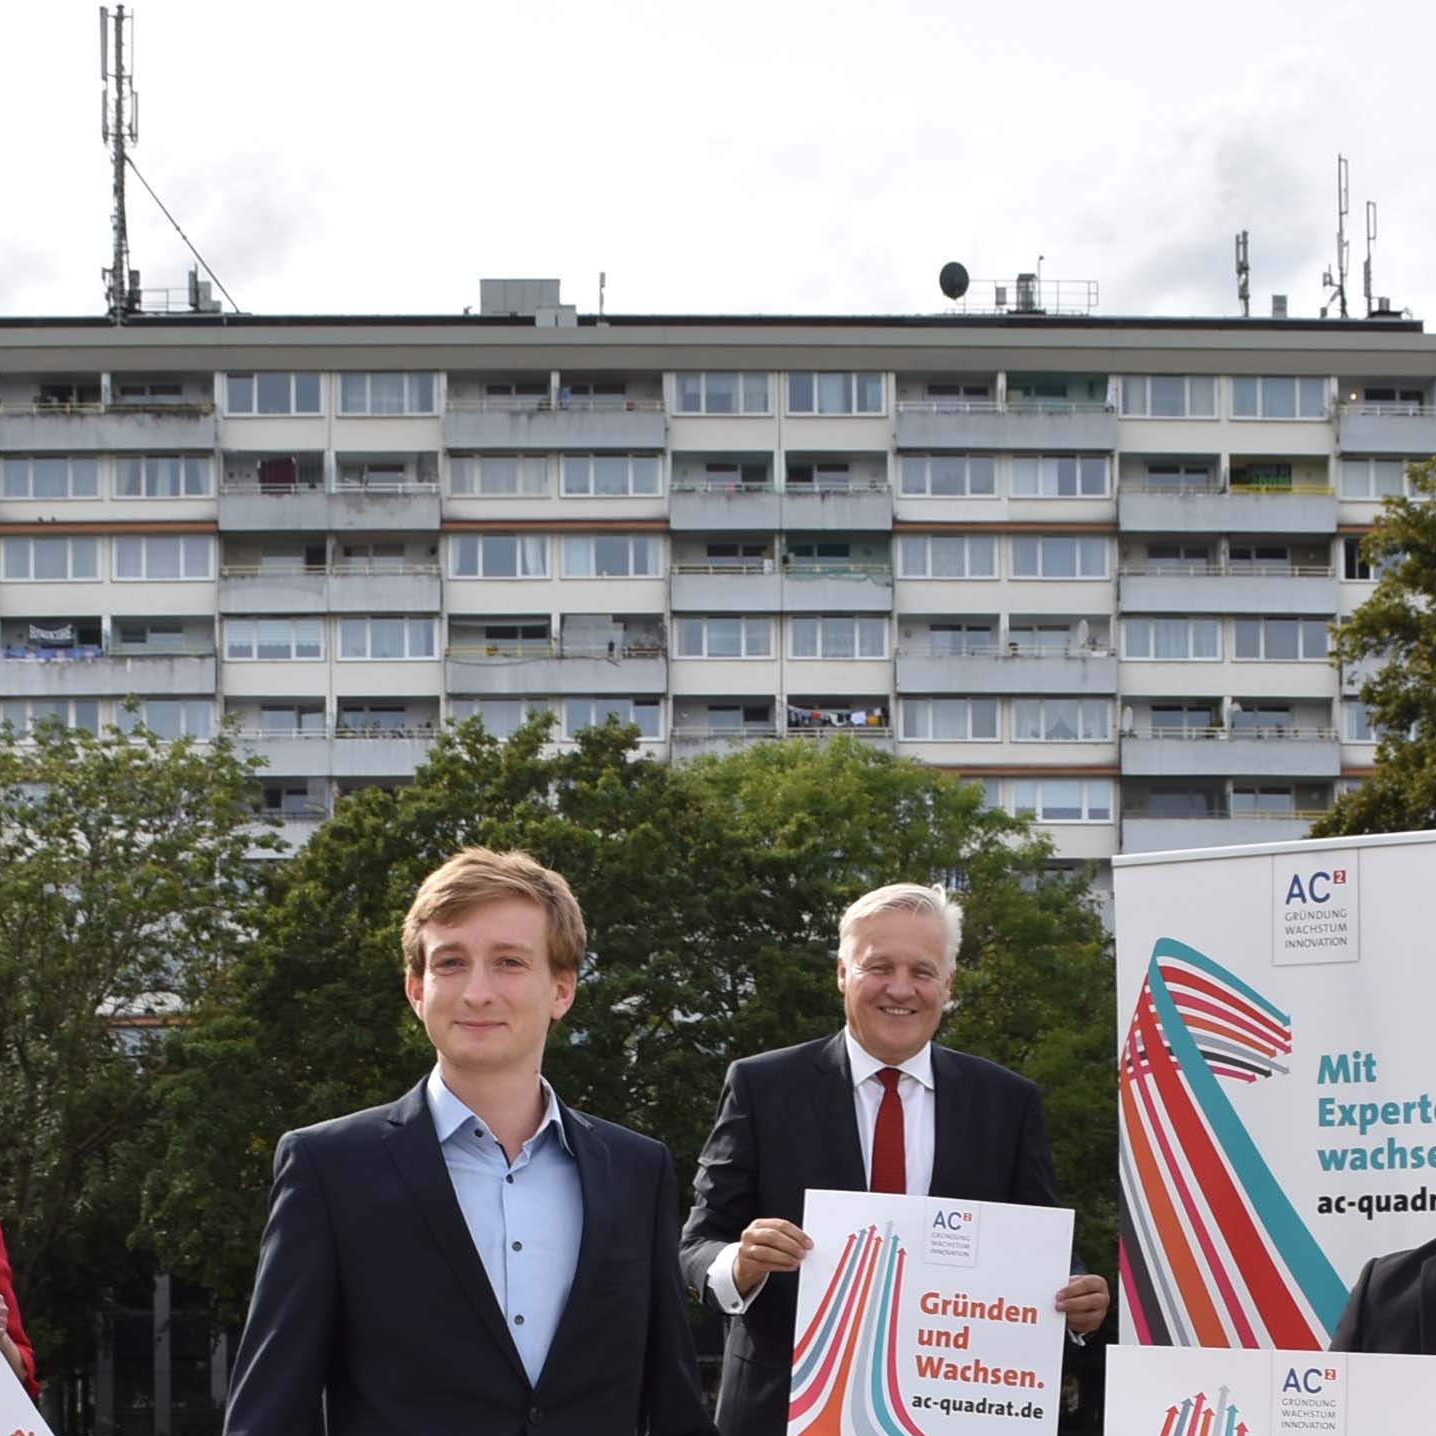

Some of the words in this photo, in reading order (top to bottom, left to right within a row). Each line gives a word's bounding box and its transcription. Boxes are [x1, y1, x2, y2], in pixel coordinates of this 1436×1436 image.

[1285, 922, 1347, 935] WACHSTUM
[1285, 936, 1347, 949] INNOVATION
[1317, 1050, 1377, 1084] Mit
[920, 1291, 1038, 1324] Gründen
[917, 1326, 970, 1349] und
[915, 1355, 1045, 1389] Wachsen.
[912, 1395, 1044, 1420] ac-quadrat.de
